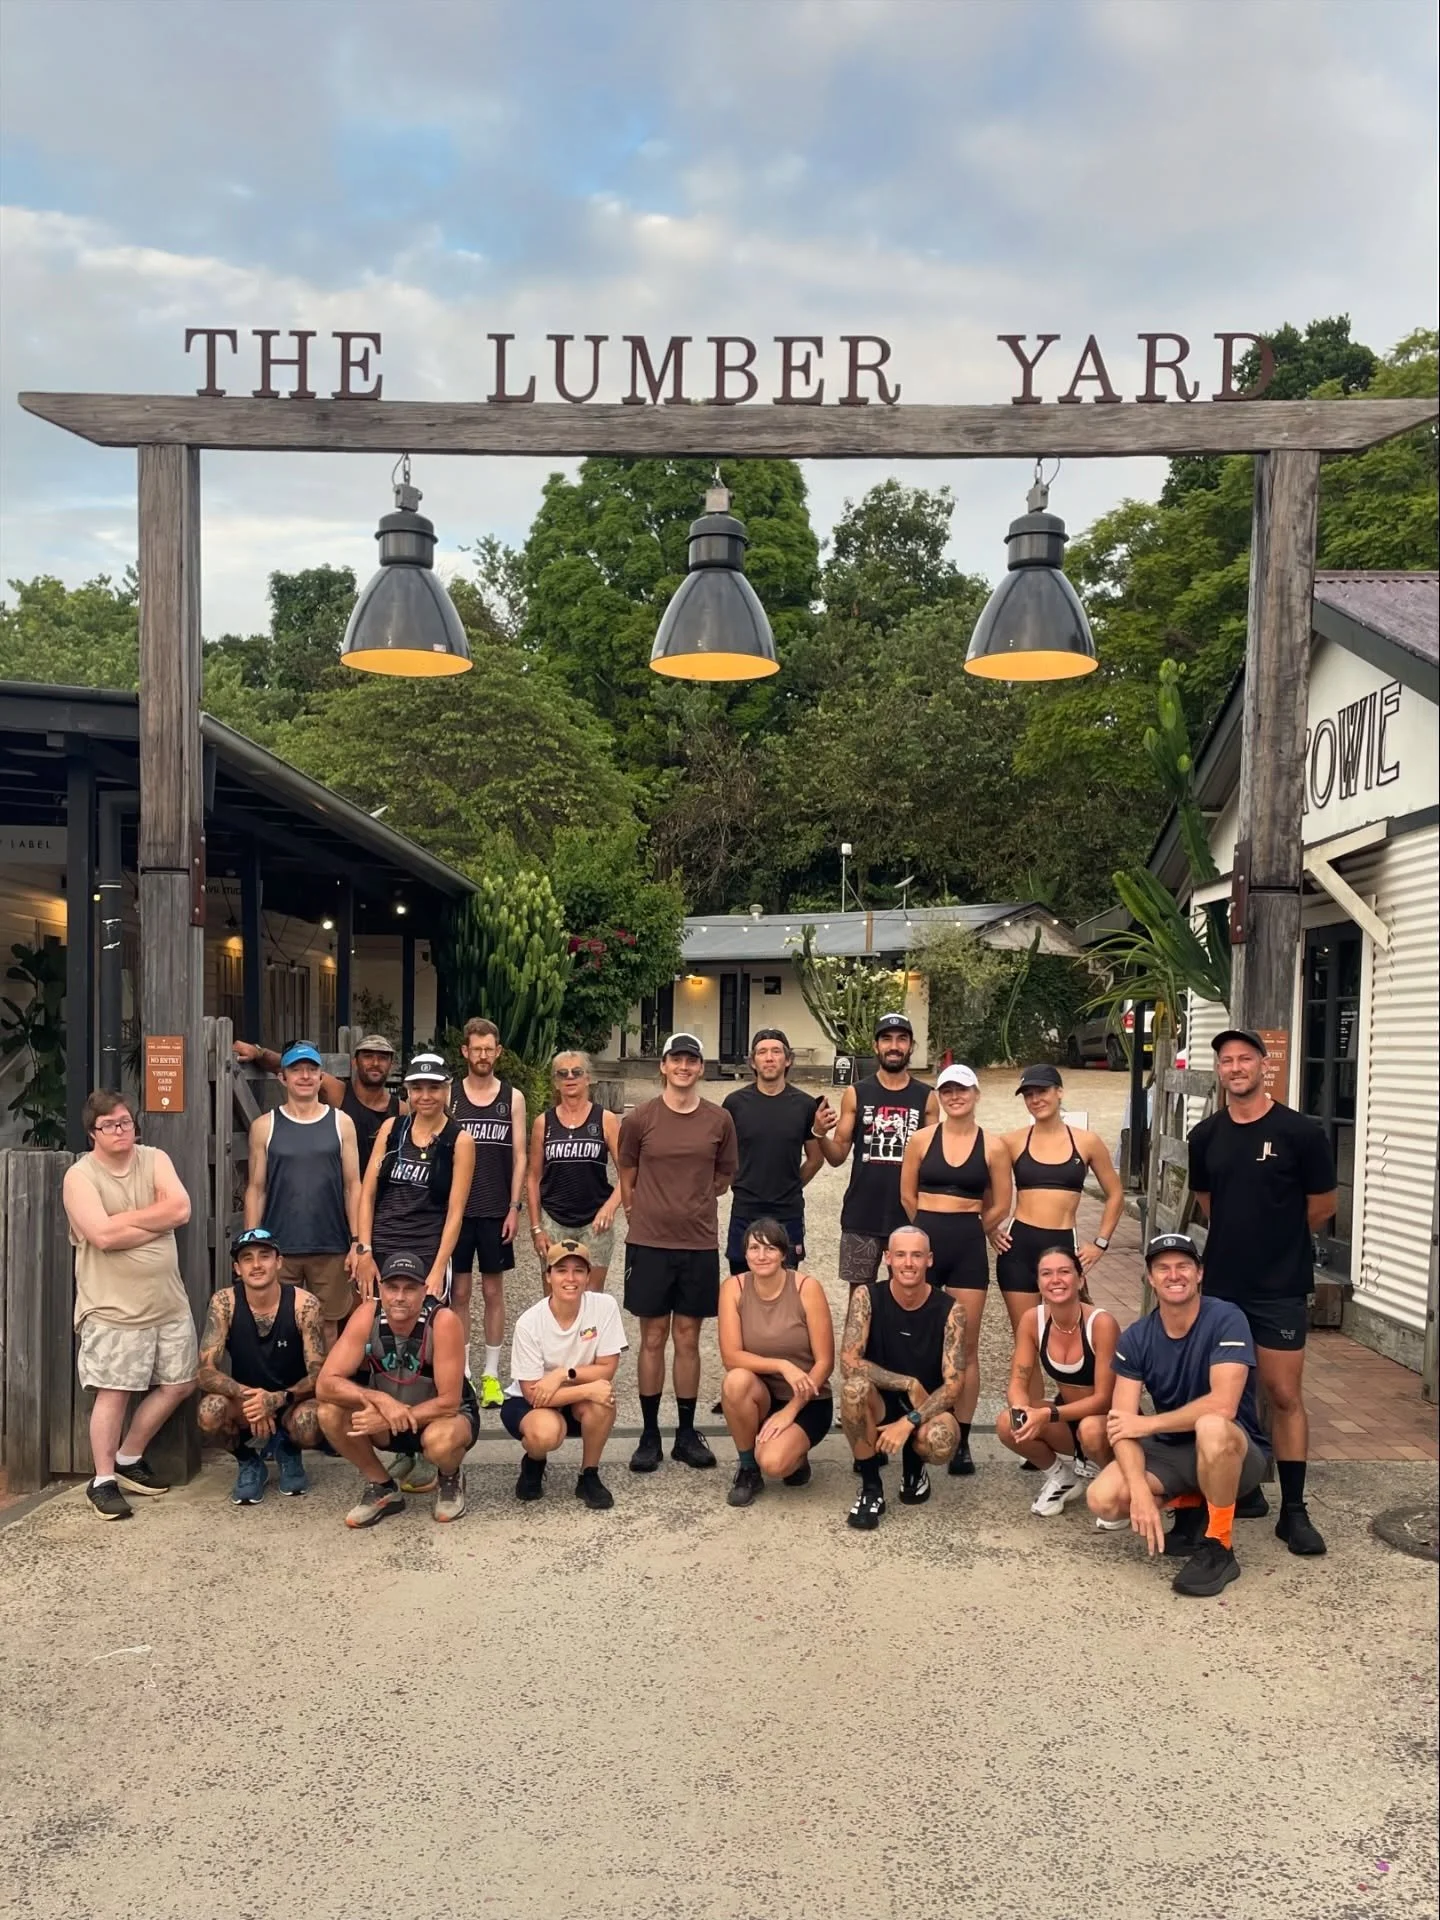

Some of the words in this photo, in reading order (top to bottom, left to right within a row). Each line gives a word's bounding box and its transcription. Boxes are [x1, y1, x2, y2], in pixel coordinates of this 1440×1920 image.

[185, 328, 383, 400] THE
[487, 333, 901, 405] LUMBER
[997, 332, 1275, 404] YARD
[461, 1123, 509, 1141] NGALOW
[545, 1142, 601, 1160] BANGALOW
